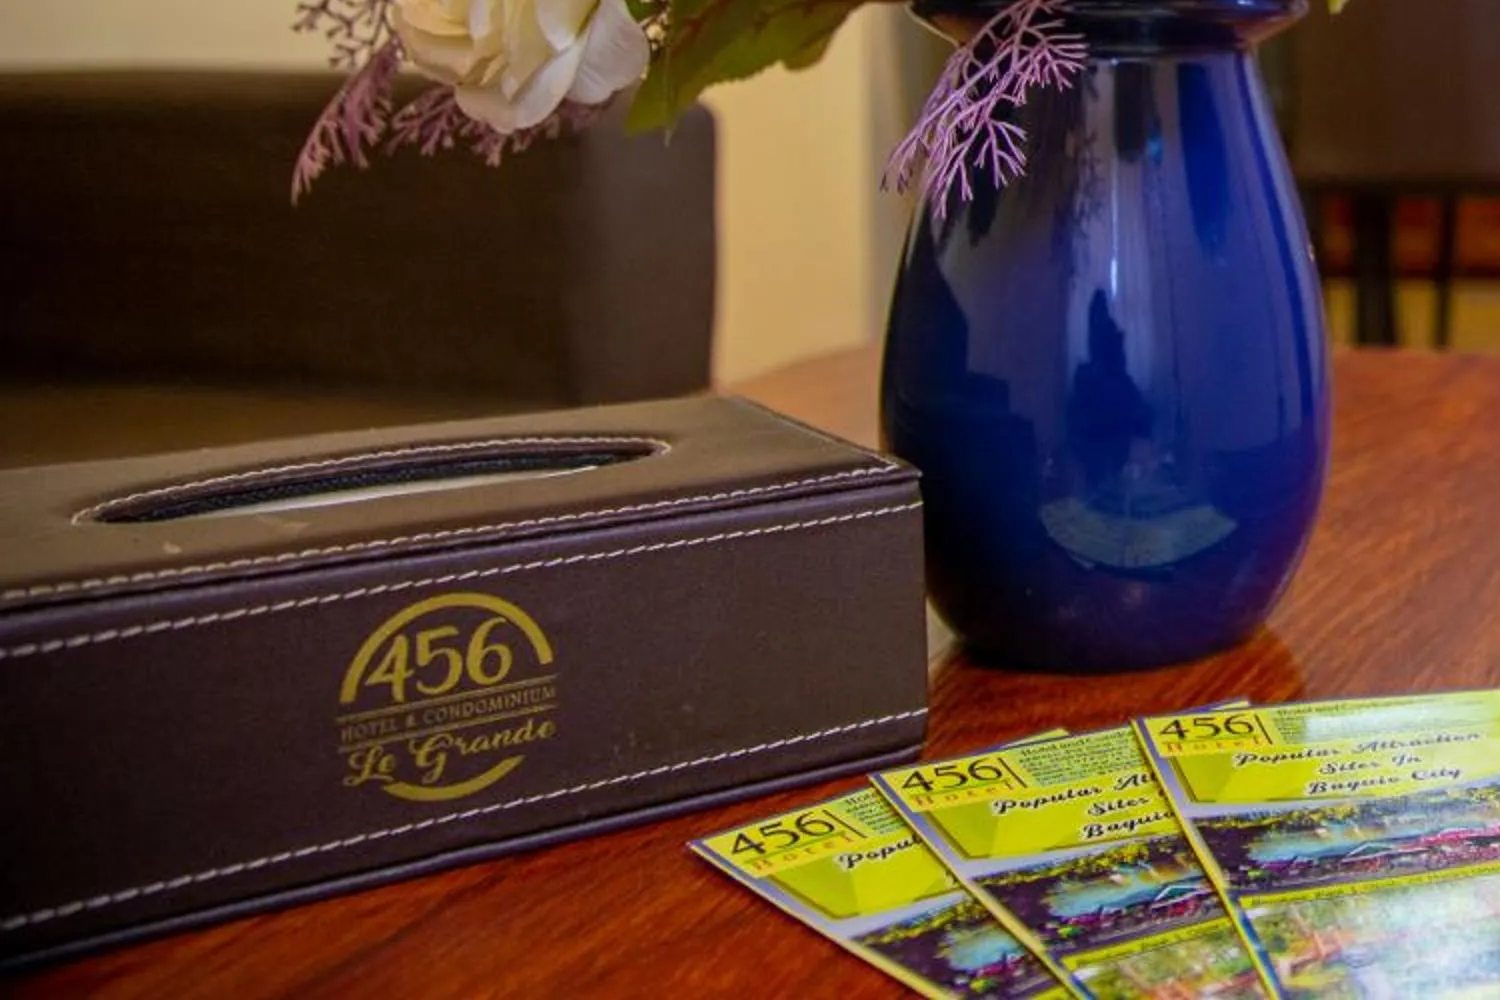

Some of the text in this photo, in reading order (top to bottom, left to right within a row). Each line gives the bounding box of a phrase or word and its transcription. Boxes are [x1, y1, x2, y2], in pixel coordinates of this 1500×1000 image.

[364, 617, 513, 701] 456
[341, 685, 556, 743] HOTEL & CONDOMINIUM
[1160, 713, 1254, 740] 456
[342, 719, 557, 786] Le Grande
[1235, 732, 1480, 765] Popular Attraction
[902, 758, 1002, 792] 456
[1308, 767, 1462, 794] Baguio City
[1319, 760, 1381, 775] Sites
[993, 785, 1102, 814] Popular
[1088, 796, 1150, 815] Sites
[731, 811, 835, 855] 456
